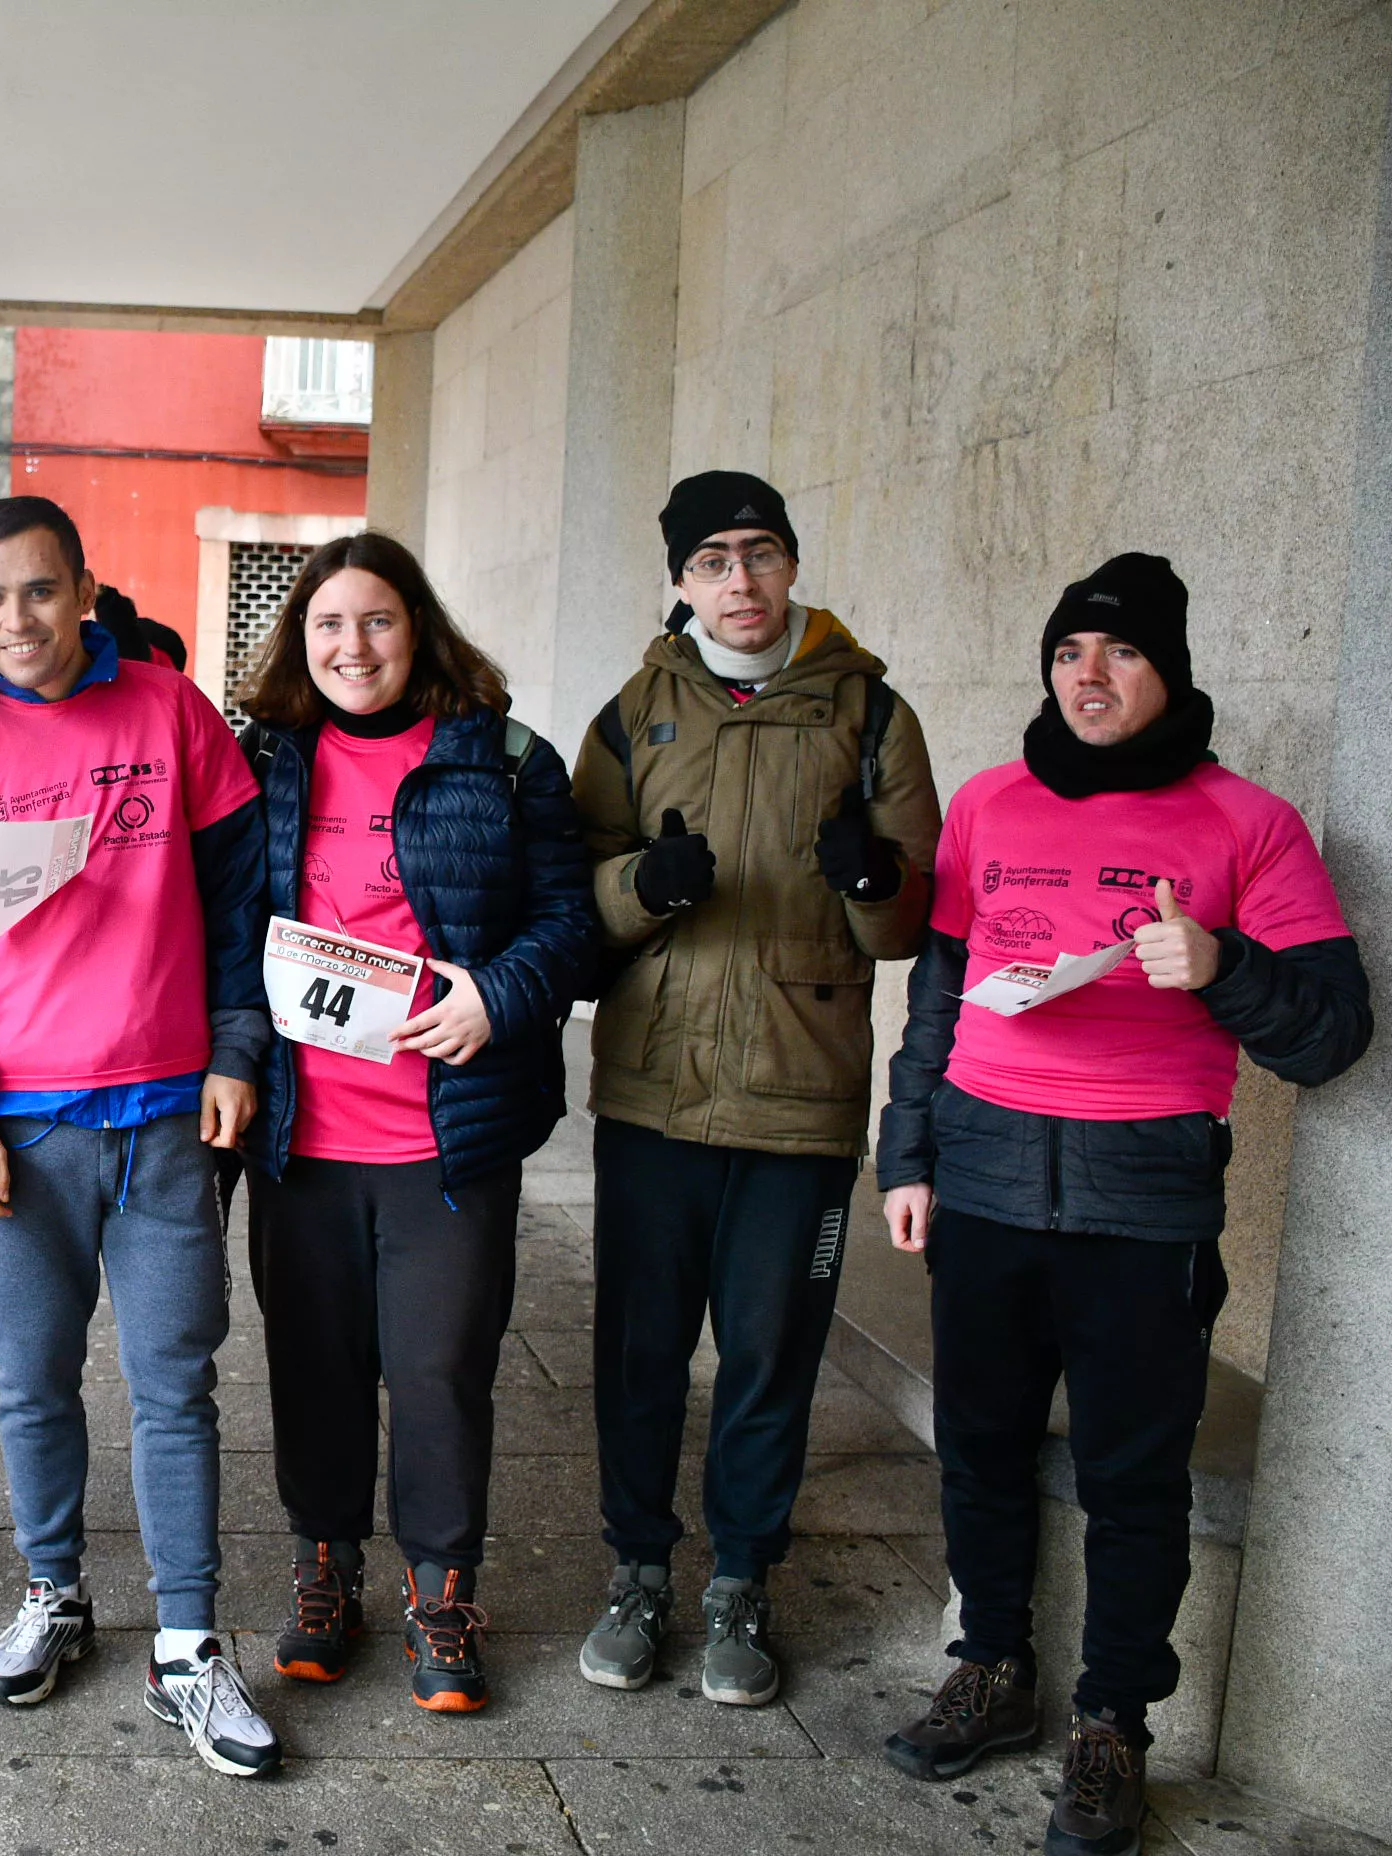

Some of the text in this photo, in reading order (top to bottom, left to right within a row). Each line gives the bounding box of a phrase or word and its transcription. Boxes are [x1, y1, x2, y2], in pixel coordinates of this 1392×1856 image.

[10, 781, 68, 805] Ayuntamiento
[11, 790, 71, 815] Ponferrada
[103, 836, 129, 845] Pacto
[139, 829, 171, 841] Estado
[1005, 866, 1071, 876] Ayuntamiento
[364, 883, 391, 893] Pacto
[1003, 876, 1069, 889] Ponferrada
[995, 922, 1052, 941] Ponferrada
[281, 930, 409, 974] Carrera de la mujer
[993, 936, 1031, 949] deporte
[277, 946, 367, 978] 10 de Marzo 2024
[299, 976, 356, 1028] 44
[809, 1208, 843, 1279] PUMA
